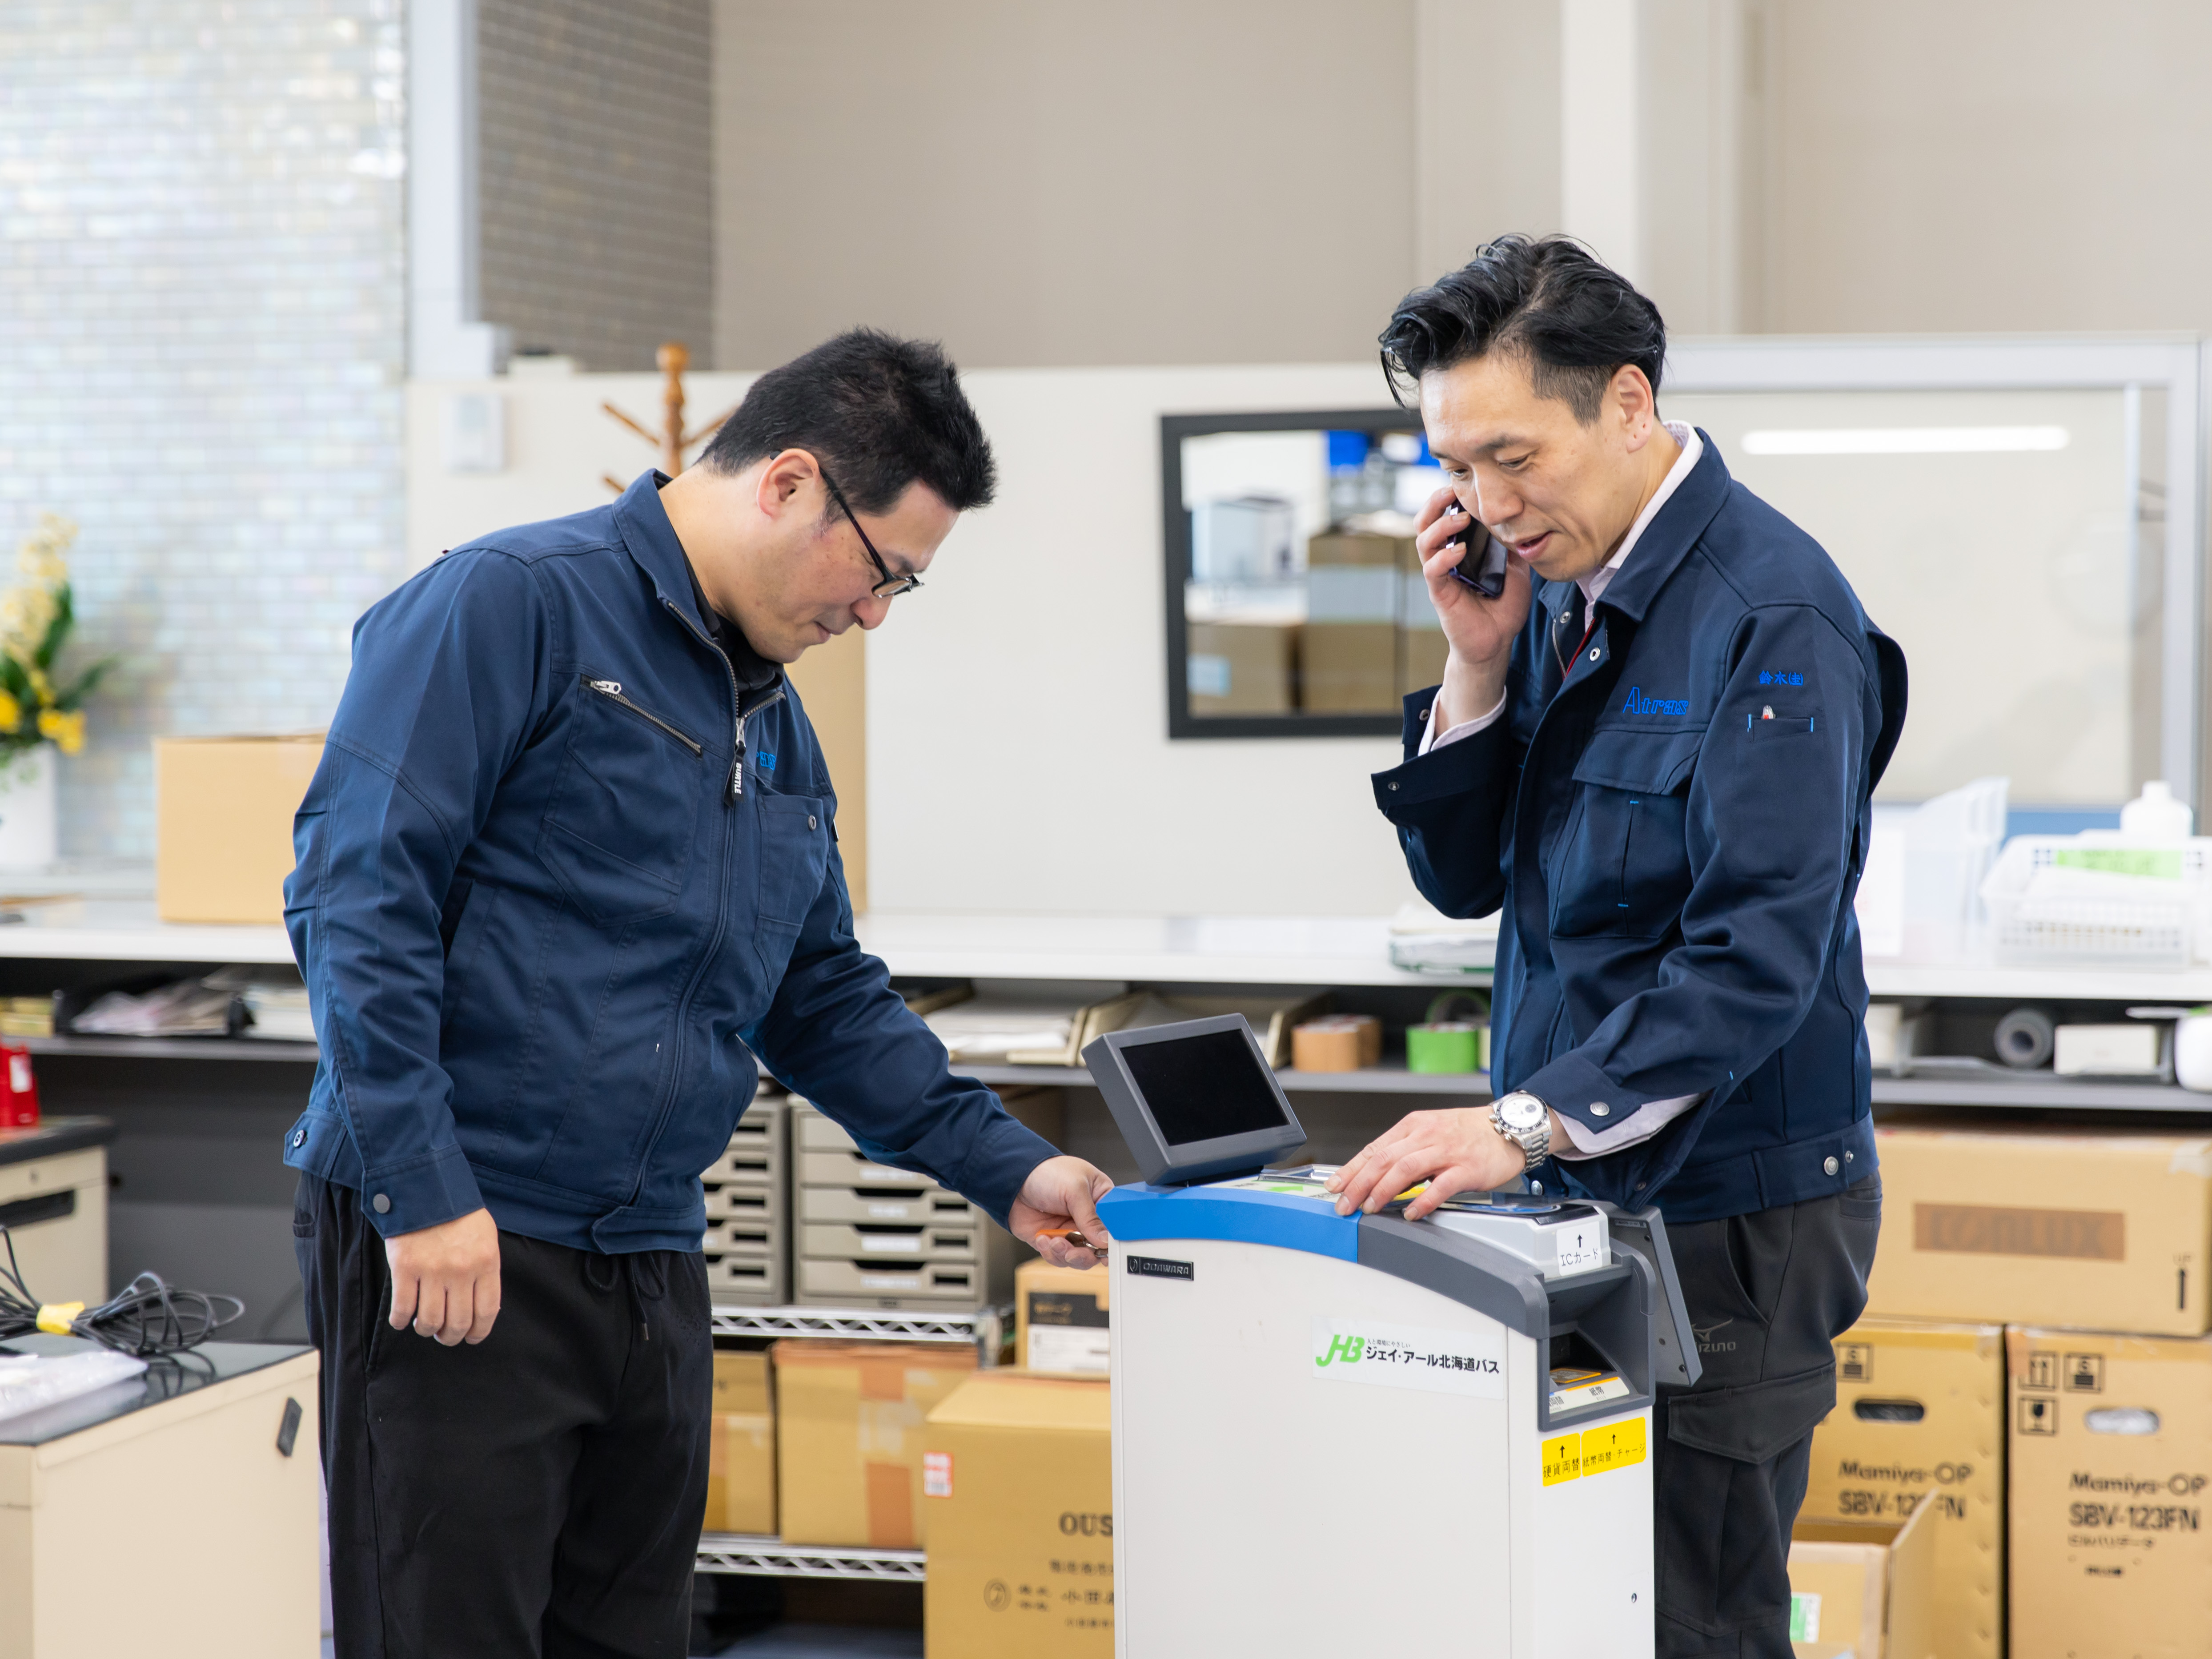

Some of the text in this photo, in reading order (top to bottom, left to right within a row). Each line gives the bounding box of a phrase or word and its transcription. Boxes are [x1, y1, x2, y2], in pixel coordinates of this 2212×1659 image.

[734, 762, 742, 795] BURTLE
[1560, 1248, 1598, 1266] ICカード
[1143, 1263, 1189, 1275] ODAWARA
[1367, 1338, 1411, 1348] 人と環境にやさしい
[1589, 1386, 1605, 1397] 紙幣
[1543, 1458, 1580, 1478] 硬貨両替
[1839, 1459, 1974, 1485] Mamiya-OP
[2070, 1470, 2208, 1497] Mamiya-OP
[2069, 1502, 2201, 1532] SBV-123FN
